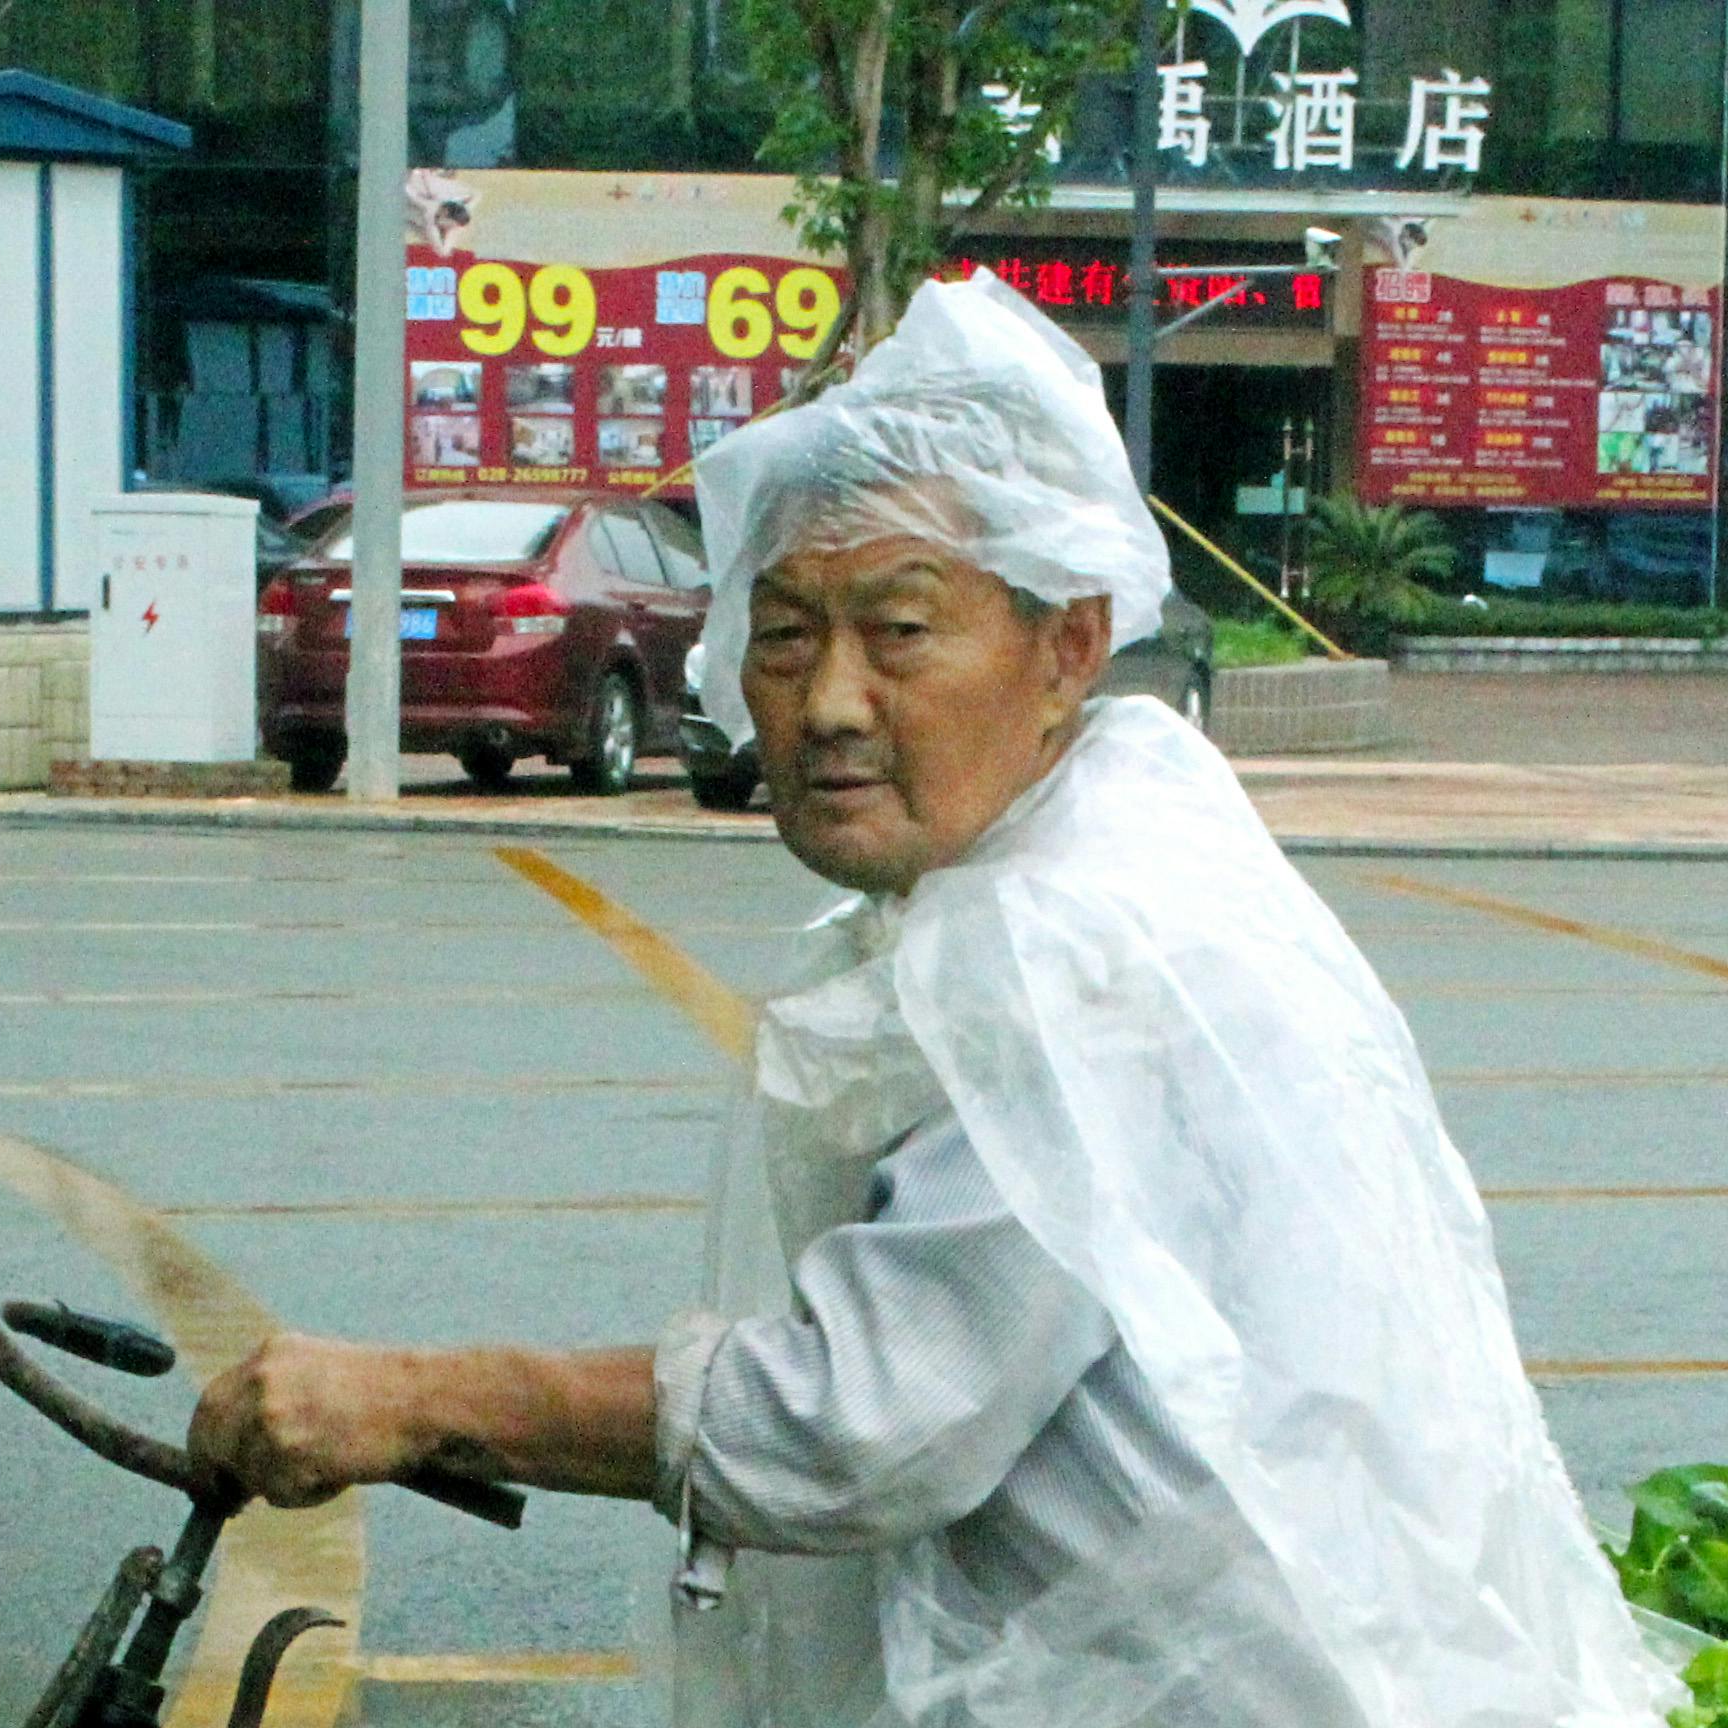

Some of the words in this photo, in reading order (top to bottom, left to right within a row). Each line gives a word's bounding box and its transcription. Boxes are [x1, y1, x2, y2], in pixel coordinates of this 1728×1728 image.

[981, 64, 1492, 171] 禹酒店
[458, 262, 597, 357] 99
[707, 266, 841, 360] 69
